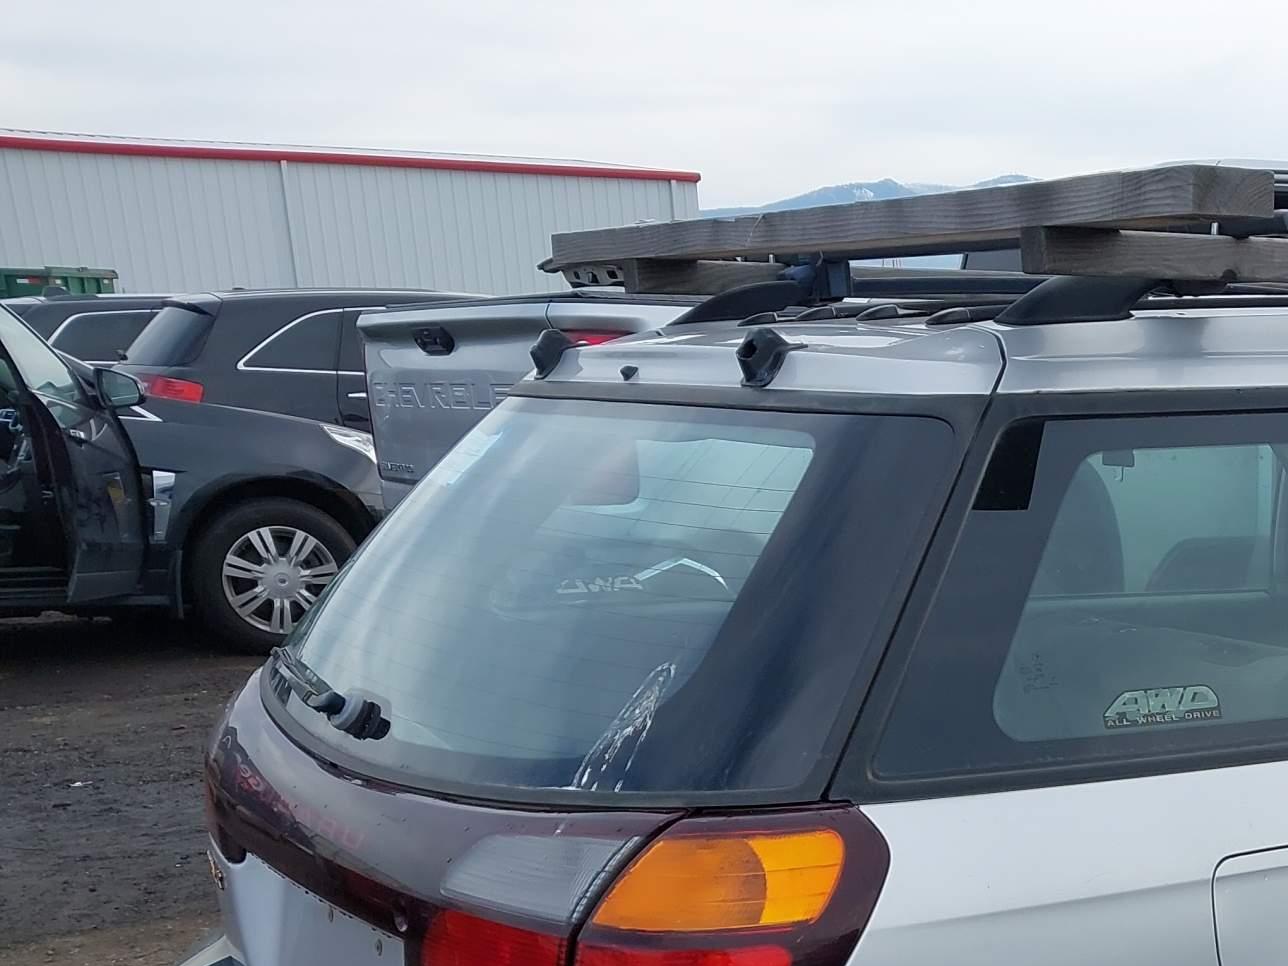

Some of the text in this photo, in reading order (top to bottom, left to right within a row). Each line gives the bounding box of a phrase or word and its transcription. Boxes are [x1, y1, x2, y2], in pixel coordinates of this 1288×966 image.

[373, 382, 514, 410] CHEVROLE
[1104, 685, 1218, 716] AWD
[1106, 709, 1221, 728] ALL WHEEL DRIVE
